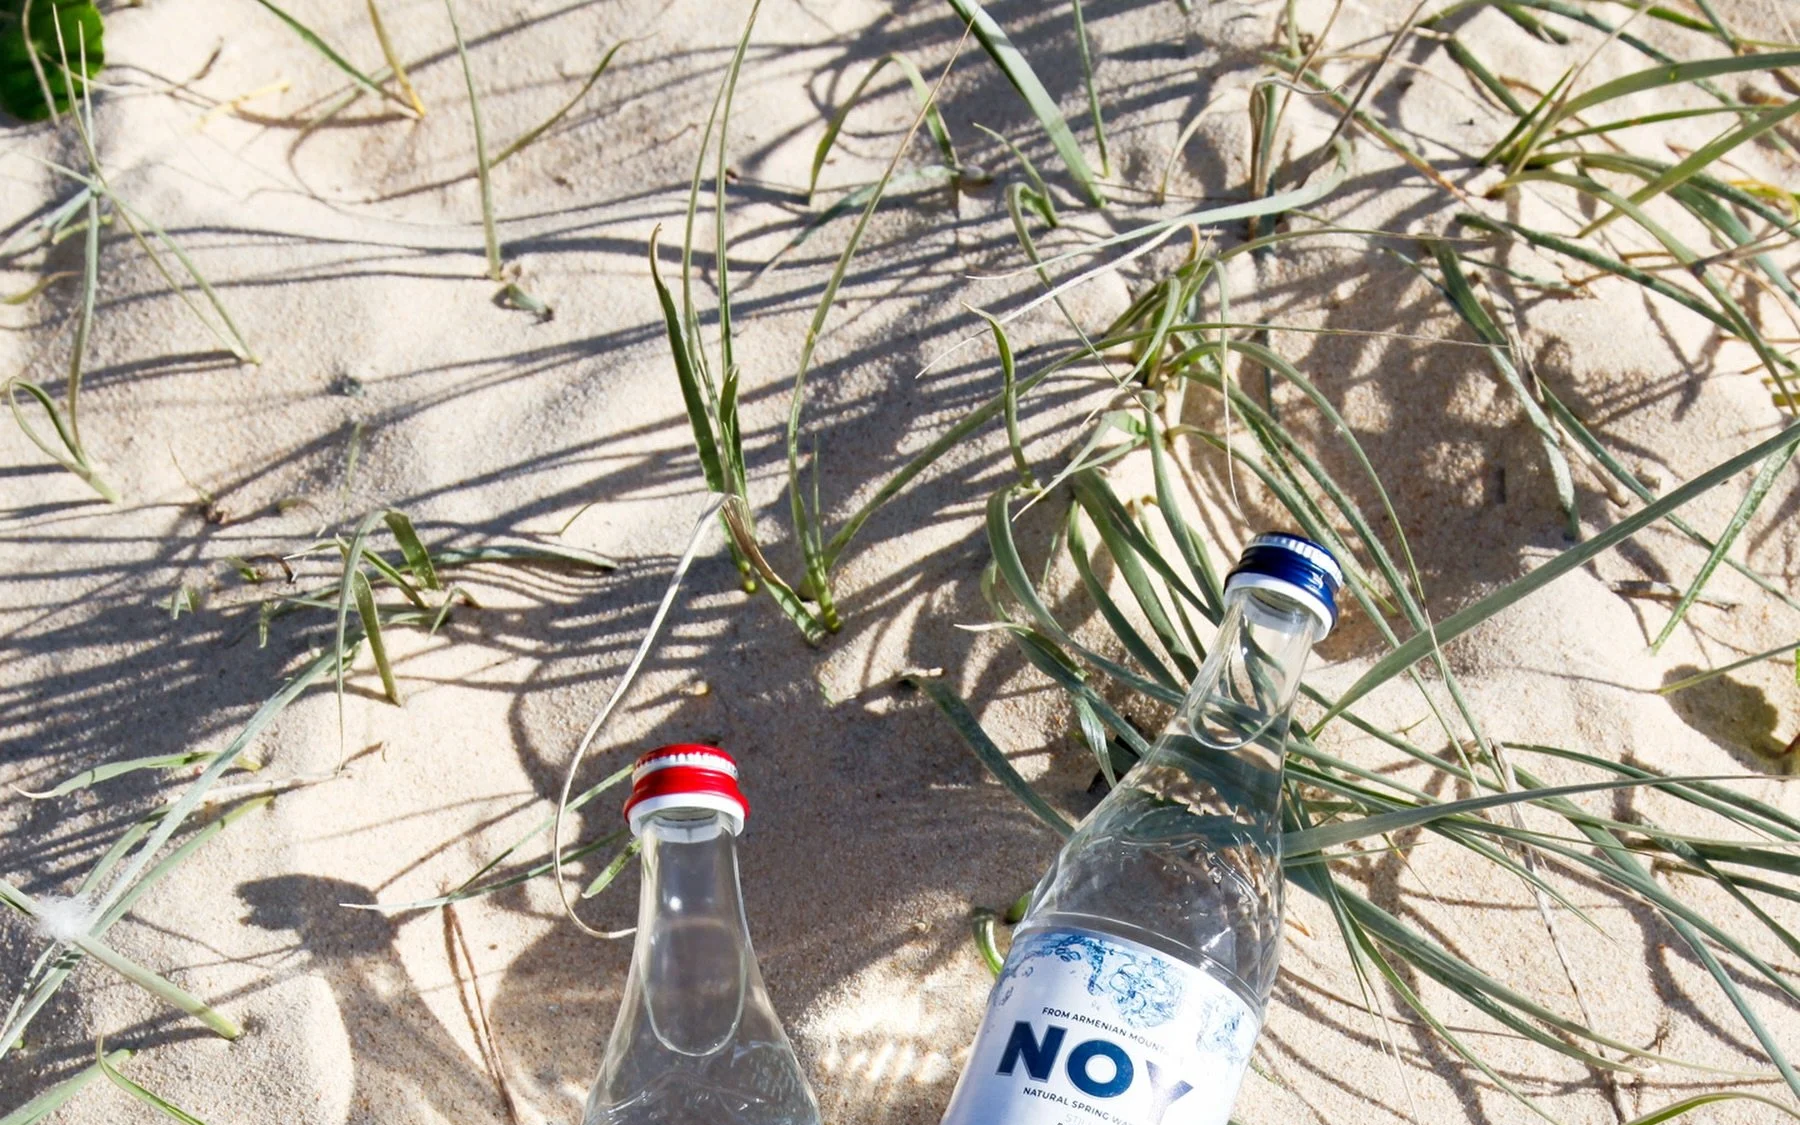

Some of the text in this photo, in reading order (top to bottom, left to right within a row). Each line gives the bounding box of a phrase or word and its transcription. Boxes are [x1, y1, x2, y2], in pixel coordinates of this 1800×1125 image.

[1041, 1006, 1071, 1020] FROM
[1071, 1013, 1128, 1037] ARMENIAN
[995, 1020, 1194, 1125] NOY
[1022, 1086, 1069, 1106] NATURAL
[1071, 1100, 1109, 1121] SPRING
